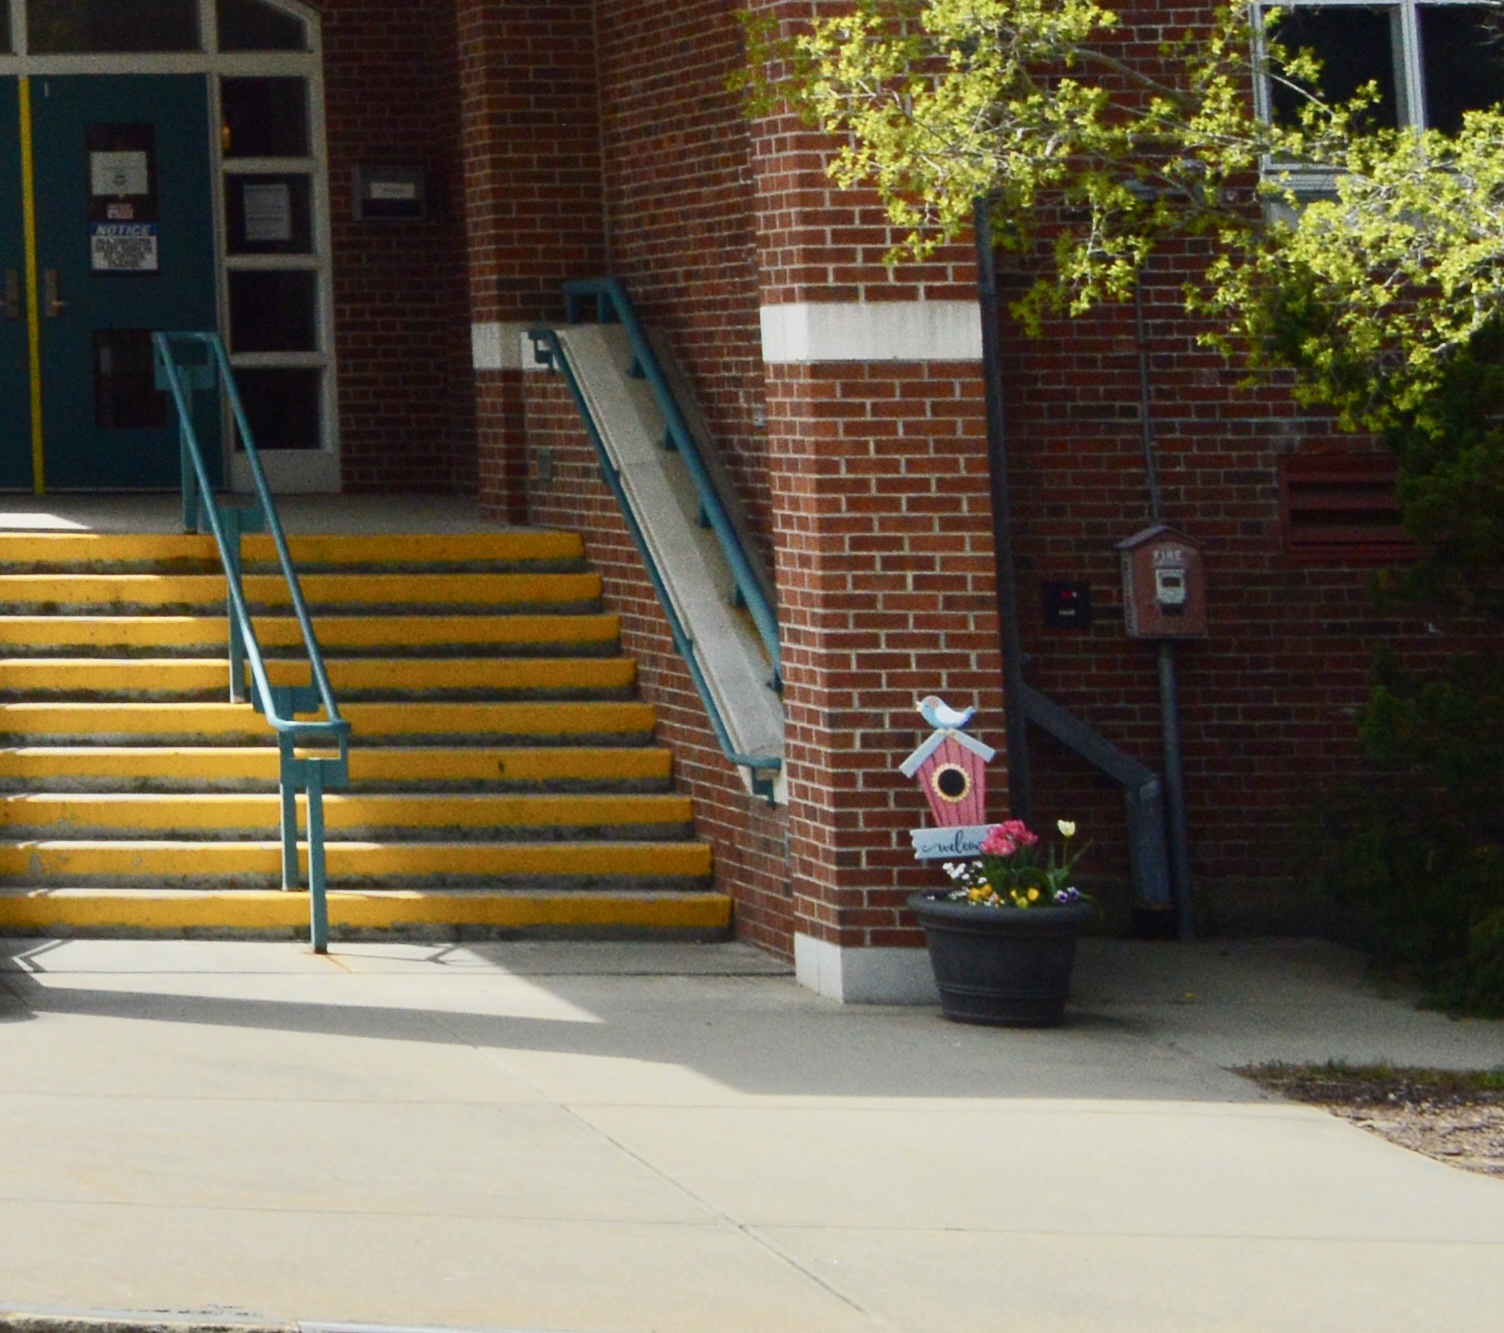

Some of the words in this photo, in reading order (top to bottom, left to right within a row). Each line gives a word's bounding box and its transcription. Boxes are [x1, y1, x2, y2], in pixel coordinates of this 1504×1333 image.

[96, 223, 151, 236] NOTICE
[1153, 549, 1182, 561] FIRE
[922, 829, 982, 854] welco
